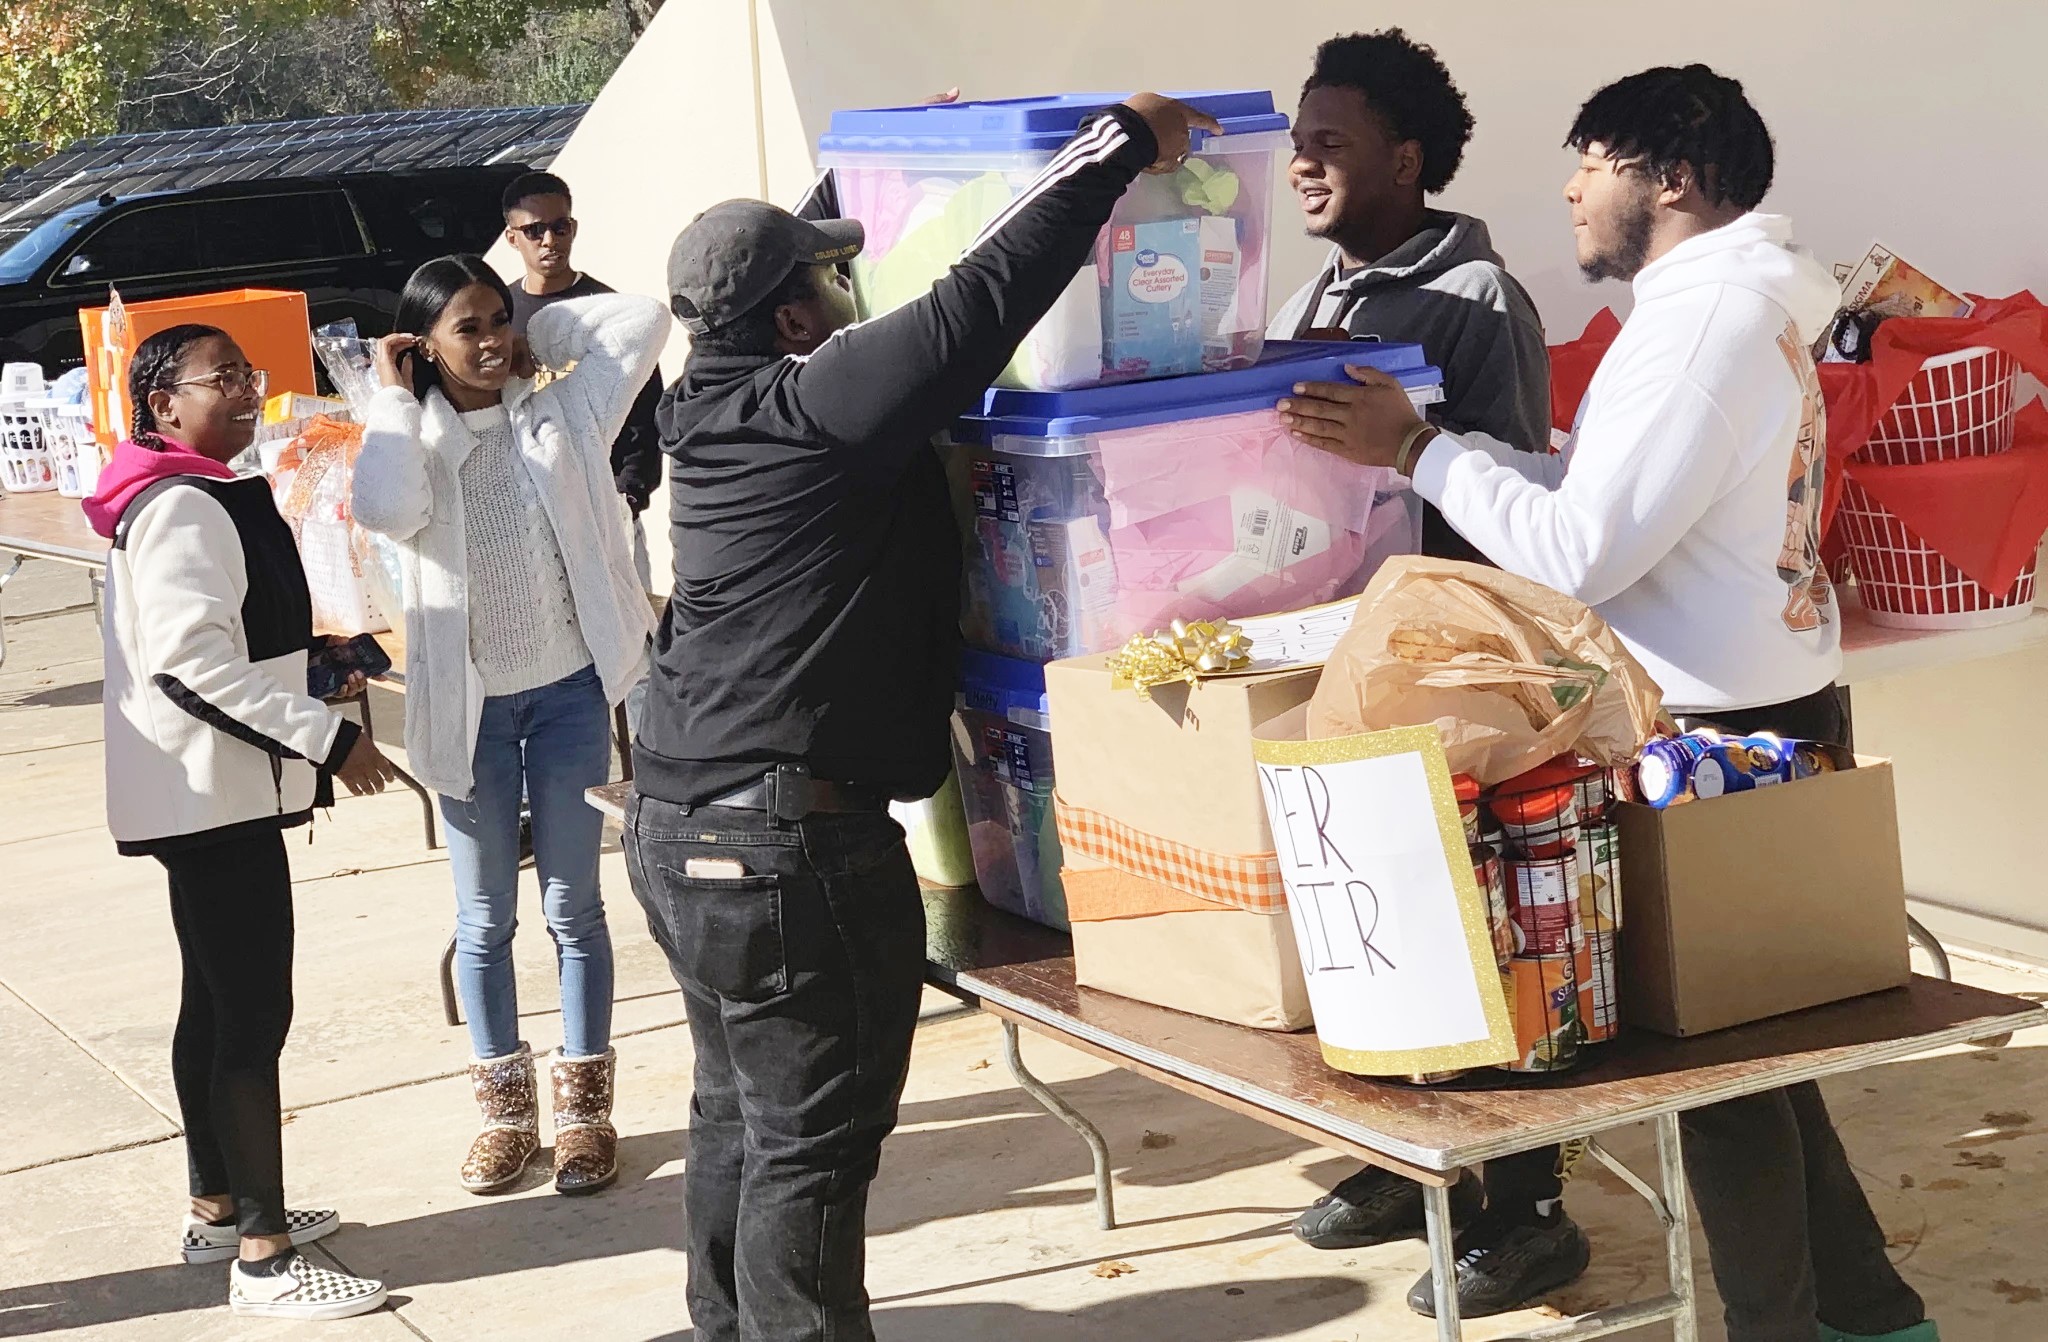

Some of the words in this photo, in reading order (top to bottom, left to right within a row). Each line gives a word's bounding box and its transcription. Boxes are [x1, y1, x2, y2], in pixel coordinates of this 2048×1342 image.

[1118, 230, 1131, 240] 48
[1143, 268, 1176, 277] Everyday
[1132, 278, 1152, 286] Clear
[1154, 274, 1185, 284] Assorted
[1145, 284, 1172, 293] Cutlery
[1848, 281, 1874, 311] SIGMA
